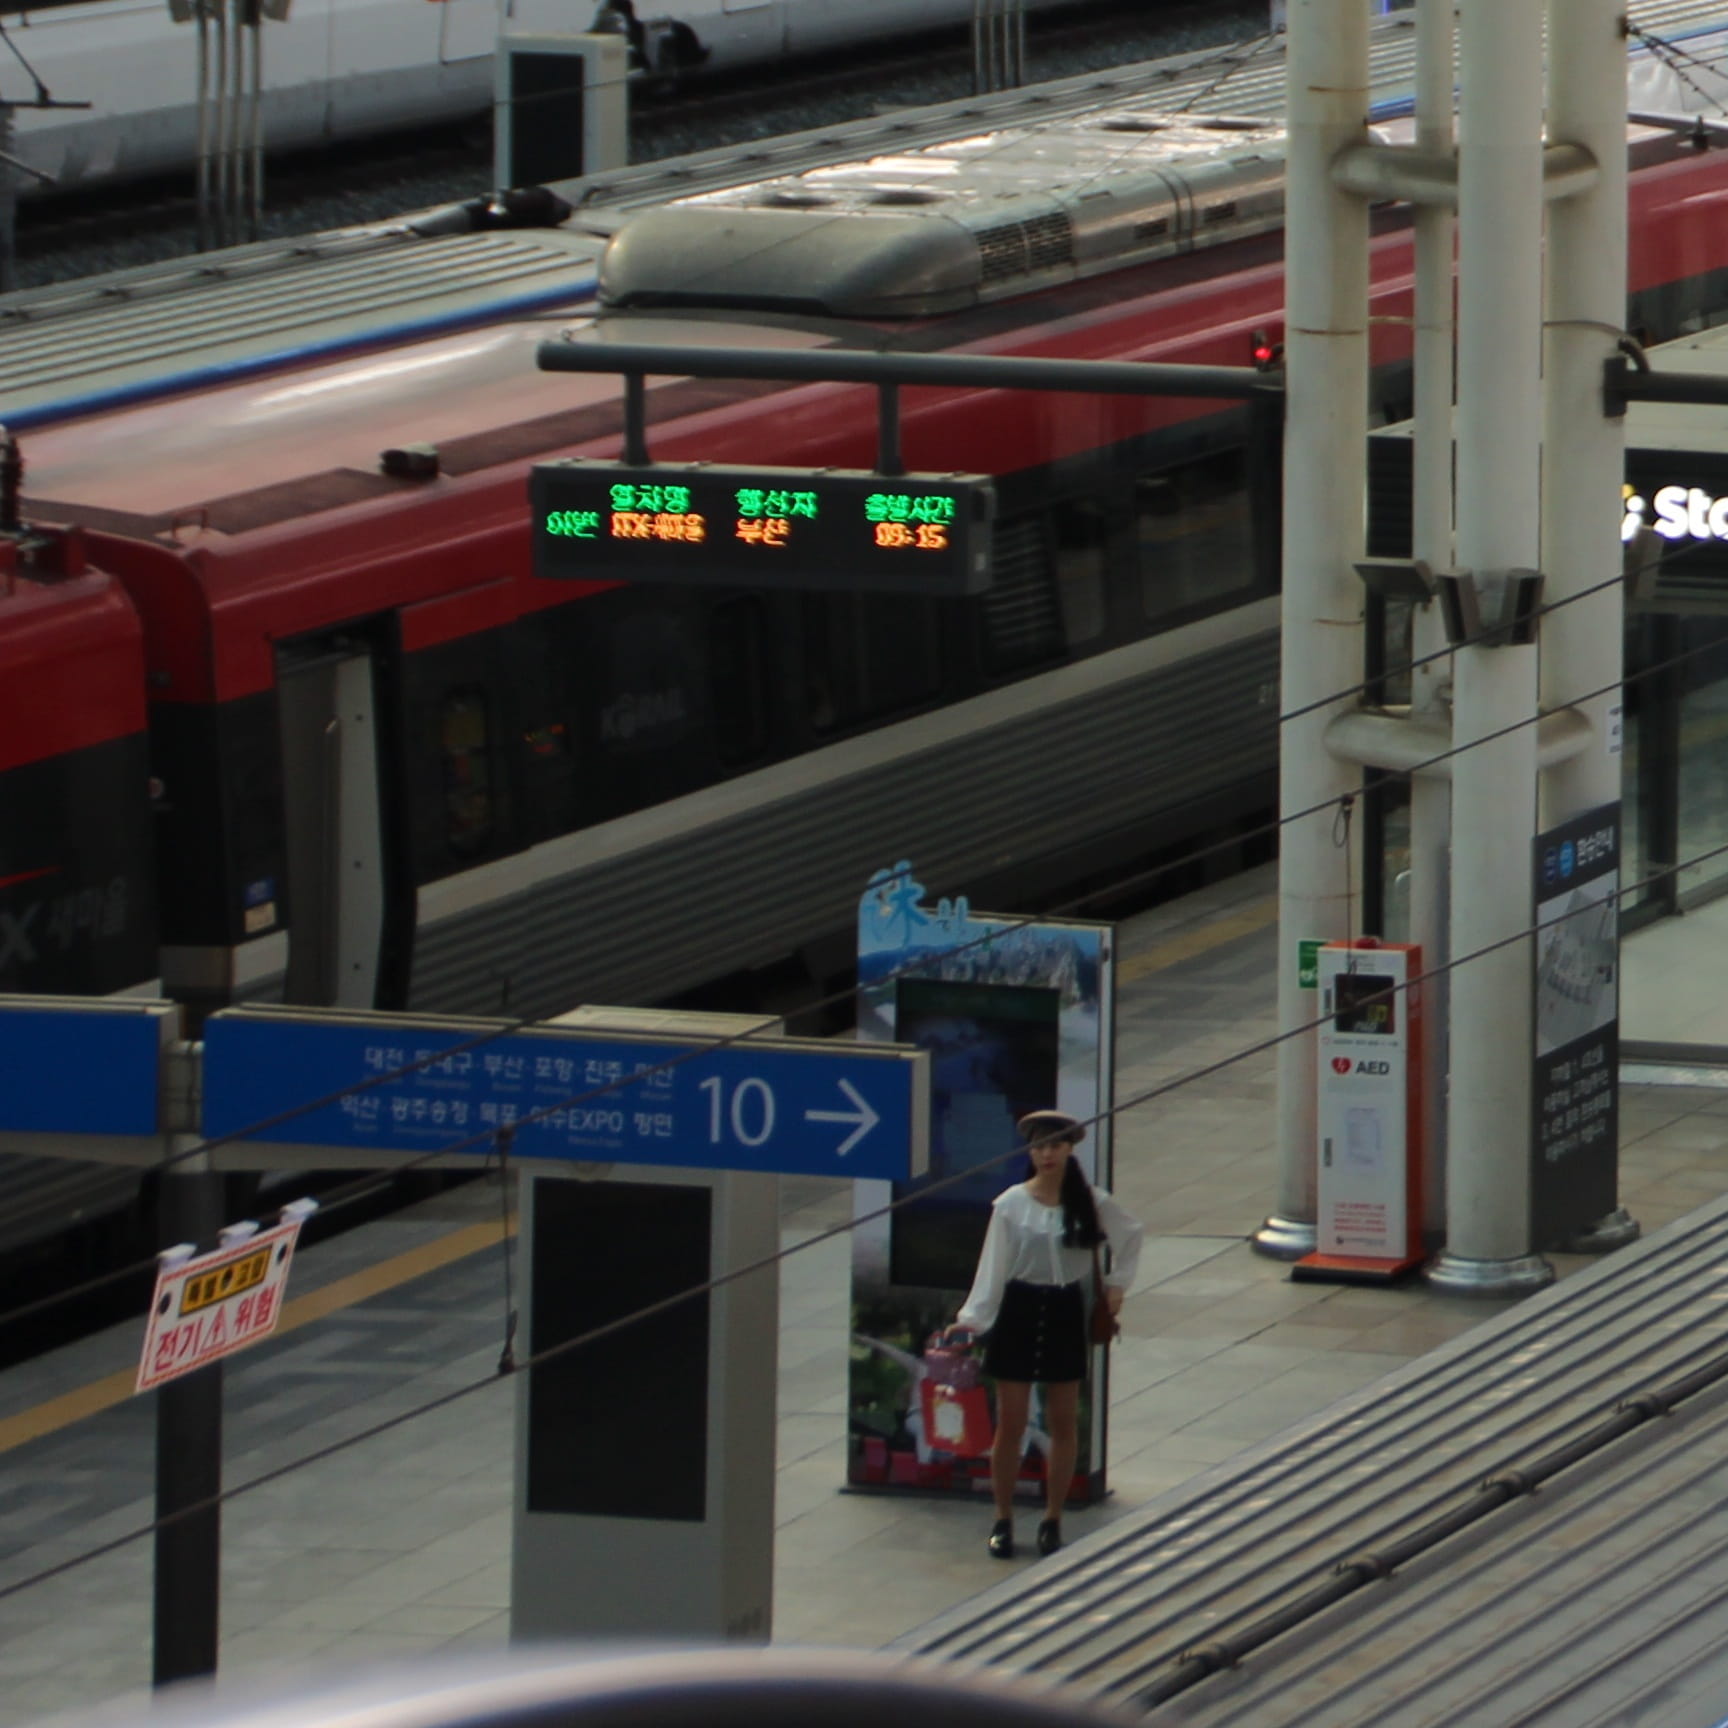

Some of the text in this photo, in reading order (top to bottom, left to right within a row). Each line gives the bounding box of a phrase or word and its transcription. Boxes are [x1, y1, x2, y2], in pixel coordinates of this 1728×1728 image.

[610, 484, 956, 525] 열차명 행선지 출발시간
[546, 510, 600, 539] 이번
[735, 517, 792, 547] 부산
[874, 521, 949, 550] 09:15
[364, 1046, 403, 1072] 대전
[484, 1054, 524, 1079] 부산
[535, 1056, 574, 1082] 포항
[1356, 1060, 1390, 1076] AED
[391, 1096, 470, 1125] 광주송정
[634, 1112, 673, 1137] 방면
[699, 1076, 775, 1147] 10
[155, 1282, 277, 1372] 전기 위험
